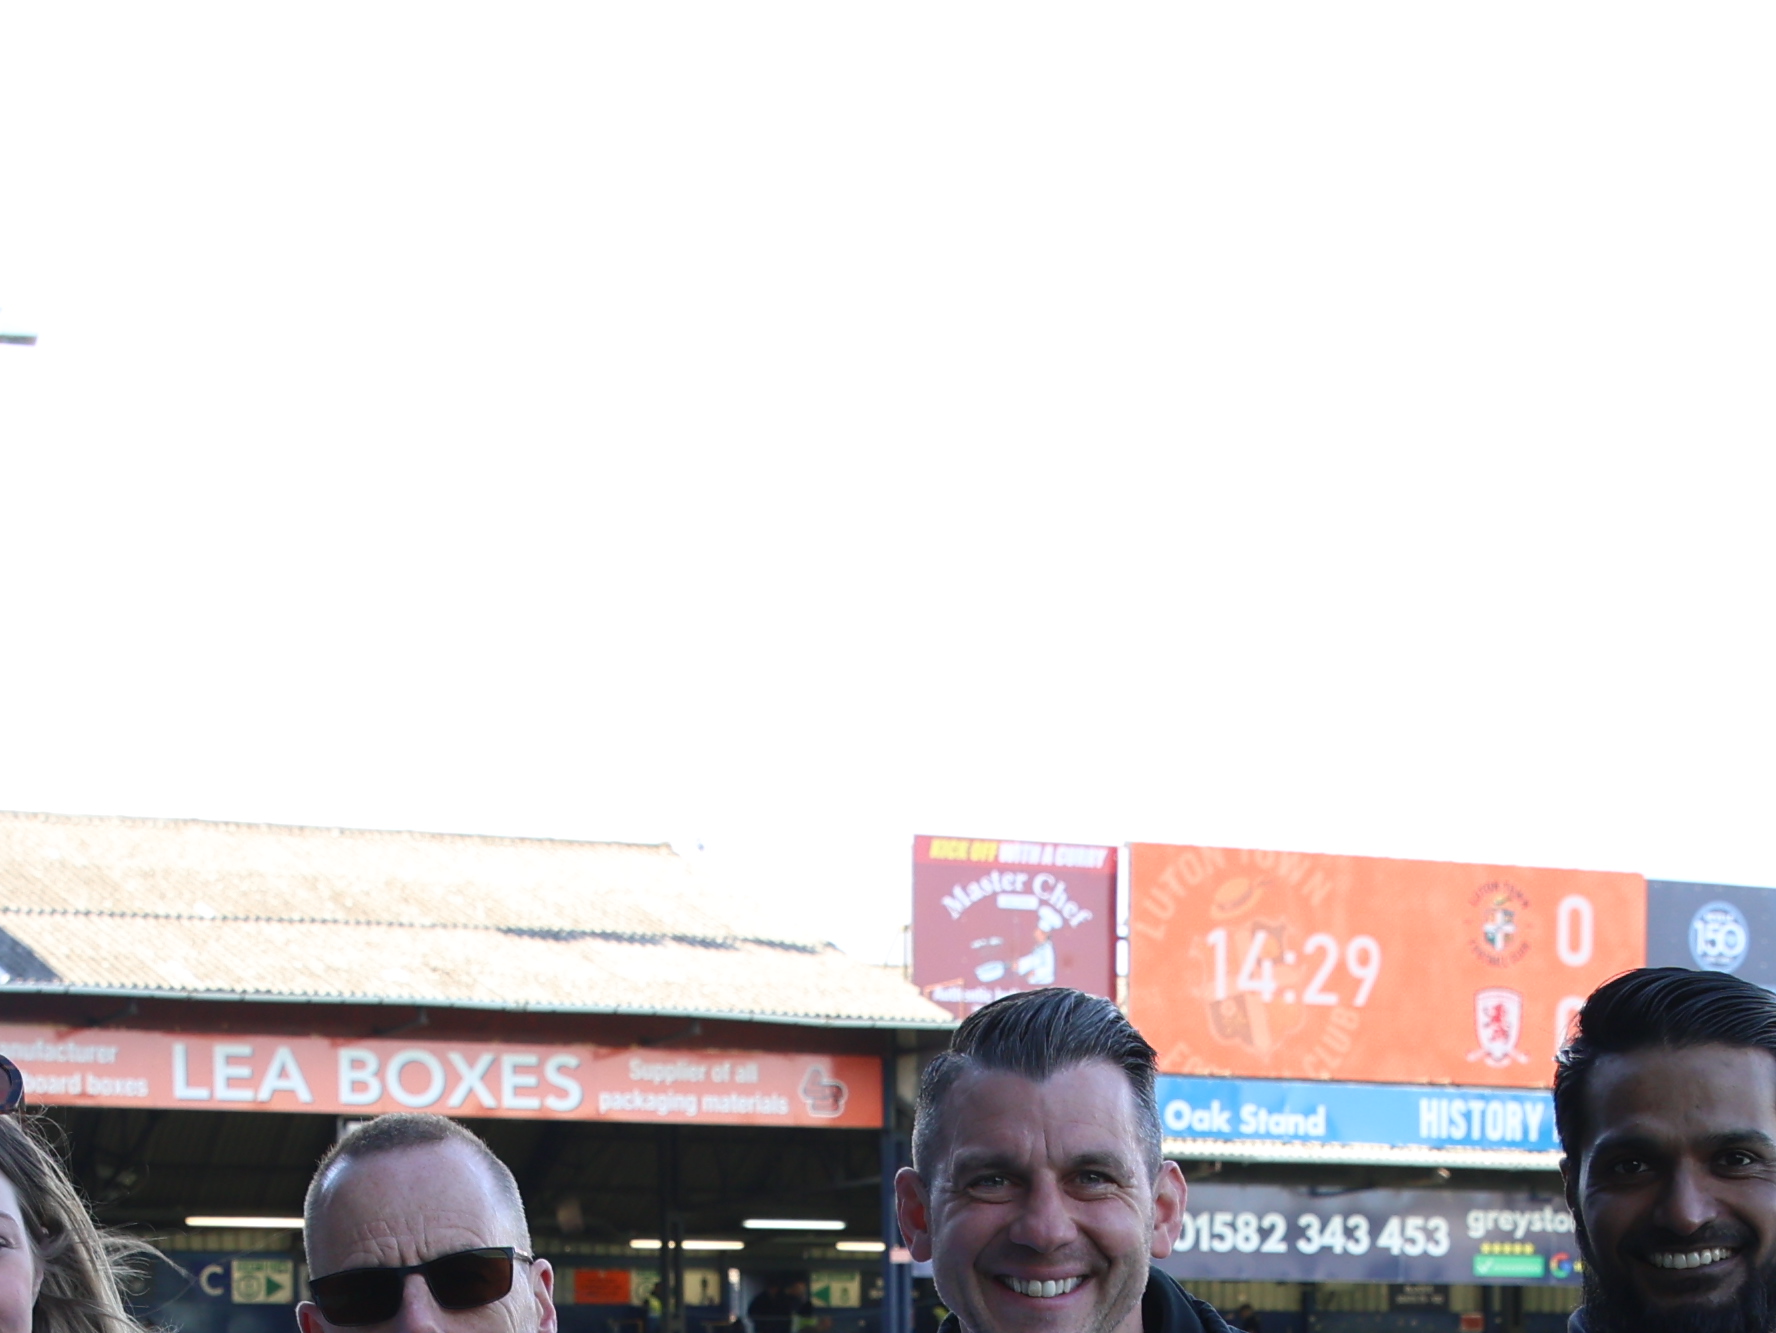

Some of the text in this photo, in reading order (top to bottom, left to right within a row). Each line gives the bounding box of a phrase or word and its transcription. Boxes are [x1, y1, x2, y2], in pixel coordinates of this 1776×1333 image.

[941, 869, 1028, 920] Master
[1556, 895, 1593, 967] 0
[1206, 926, 1382, 1008] 14:29
[87, 1073, 149, 1098] boxes
[171, 1042, 584, 1111] LEA BOXES
[629, 1059, 759, 1086] Supplier of all
[598, 1091, 790, 1117] packaging materials
[1164, 1100, 1230, 1134] Oak
[1240, 1099, 1328, 1138] Stand
[1420, 1098, 1543, 1142] HISTORY
[1173, 1211, 1451, 1258] 01582 343 453
